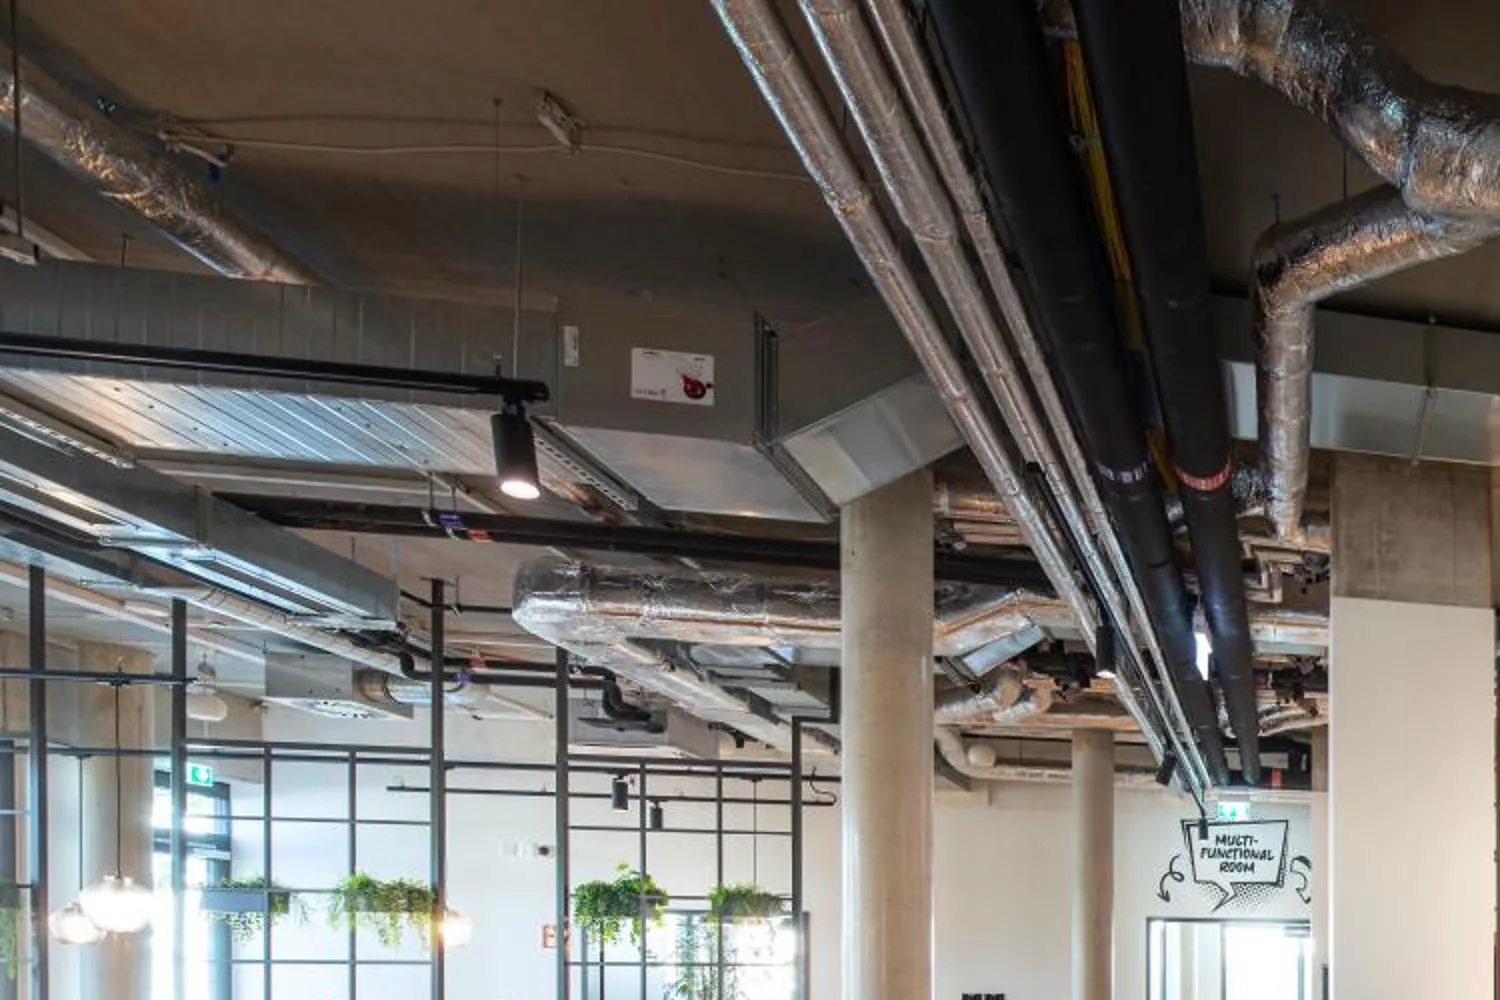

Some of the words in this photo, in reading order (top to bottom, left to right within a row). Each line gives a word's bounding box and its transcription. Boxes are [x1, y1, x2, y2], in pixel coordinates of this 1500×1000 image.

[1215, 834, 1259, 847] MULTI-
[1200, 847, 1275, 861] FUNCTIONAL
[1219, 861, 1255, 874] ROOM
